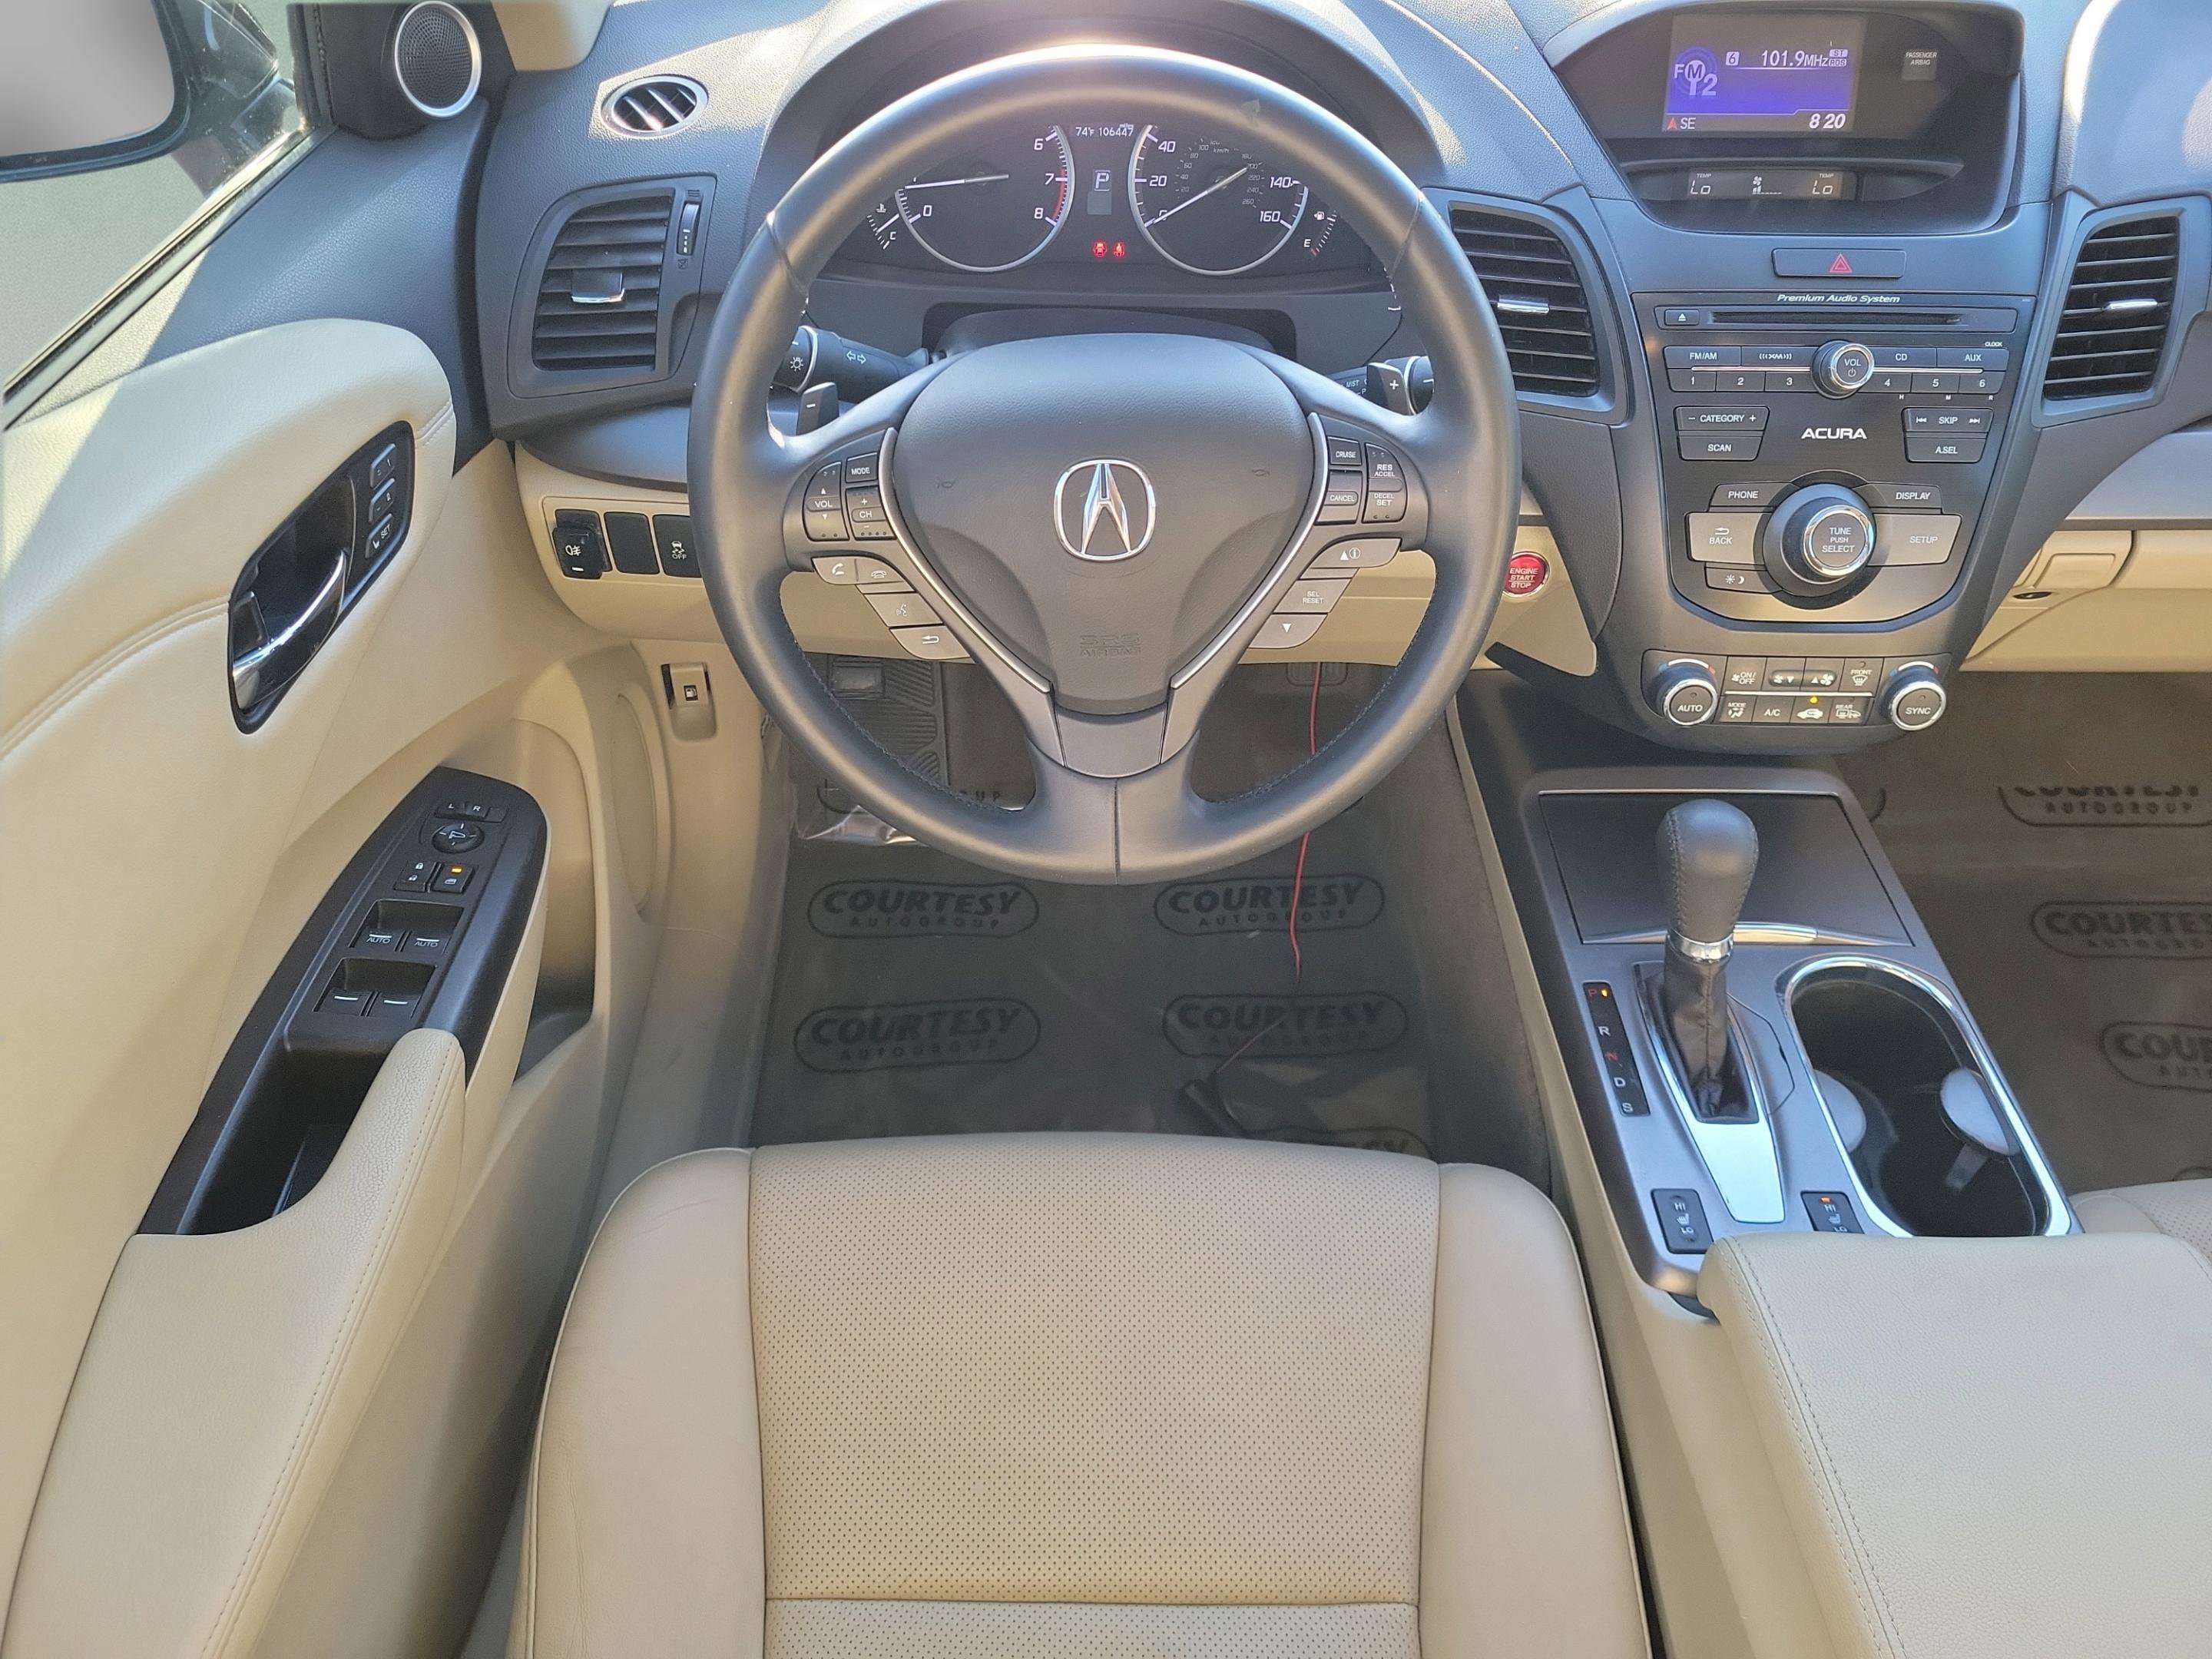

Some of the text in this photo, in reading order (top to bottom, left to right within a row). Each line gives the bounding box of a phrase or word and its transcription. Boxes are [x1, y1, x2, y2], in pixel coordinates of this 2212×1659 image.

[1680, 118, 1696, 130] SE
[1099, 127, 1134, 137] 106447
[1034, 138, 1044, 151] 6
[1157, 141, 1176, 153] 40
[1045, 174, 1055, 185] 7
[1095, 172, 1110, 189] P
[1149, 175, 1167, 187] 20
[1270, 177, 1291, 188] 140
[923, 205, 932, 217] 0
[1034, 207, 1044, 219] 8
[1260, 210, 1280, 222] 160
[1303, 239, 1311, 247] E
[1777, 293, 1900, 304] Premium Audio System
[1690, 376, 1695, 385] 1
[1737, 377, 1744, 386] 2
[1786, 377, 1793, 386] 3
[1884, 378, 1891, 387] 4
[1932, 379, 1939, 387] 5
[1979, 379, 1985, 388] 6
[1700, 414, 1745, 422] CATEGORY
[1939, 416, 1959, 425] SKIP
[1800, 428, 1867, 439] ACURA
[1728, 491, 1759, 499] PHONE
[1895, 492, 1931, 501] DISPLAY
[1709, 536, 1733, 545] BACK
[1909, 536, 1938, 545] SETUP
[1821, 545, 1856, 553] SELECT
[1677, 704, 1703, 713] AUTO
[1906, 707, 1931, 715] SYNC
[1167, 882, 1365, 913] COURTESY
[823, 889, 1022, 916] COURTESY
[366, 936, 390, 945] AUTO
[1177, 1001, 1386, 1031] COURTESY
[811, 1008, 1022, 1046] COURTESY
[1598, 1026, 1611, 1036] R
[1614, 1078, 1626, 1087] D
[1622, 1102, 1634, 1112] S
[1674, 1202, 1685, 1210] HI
